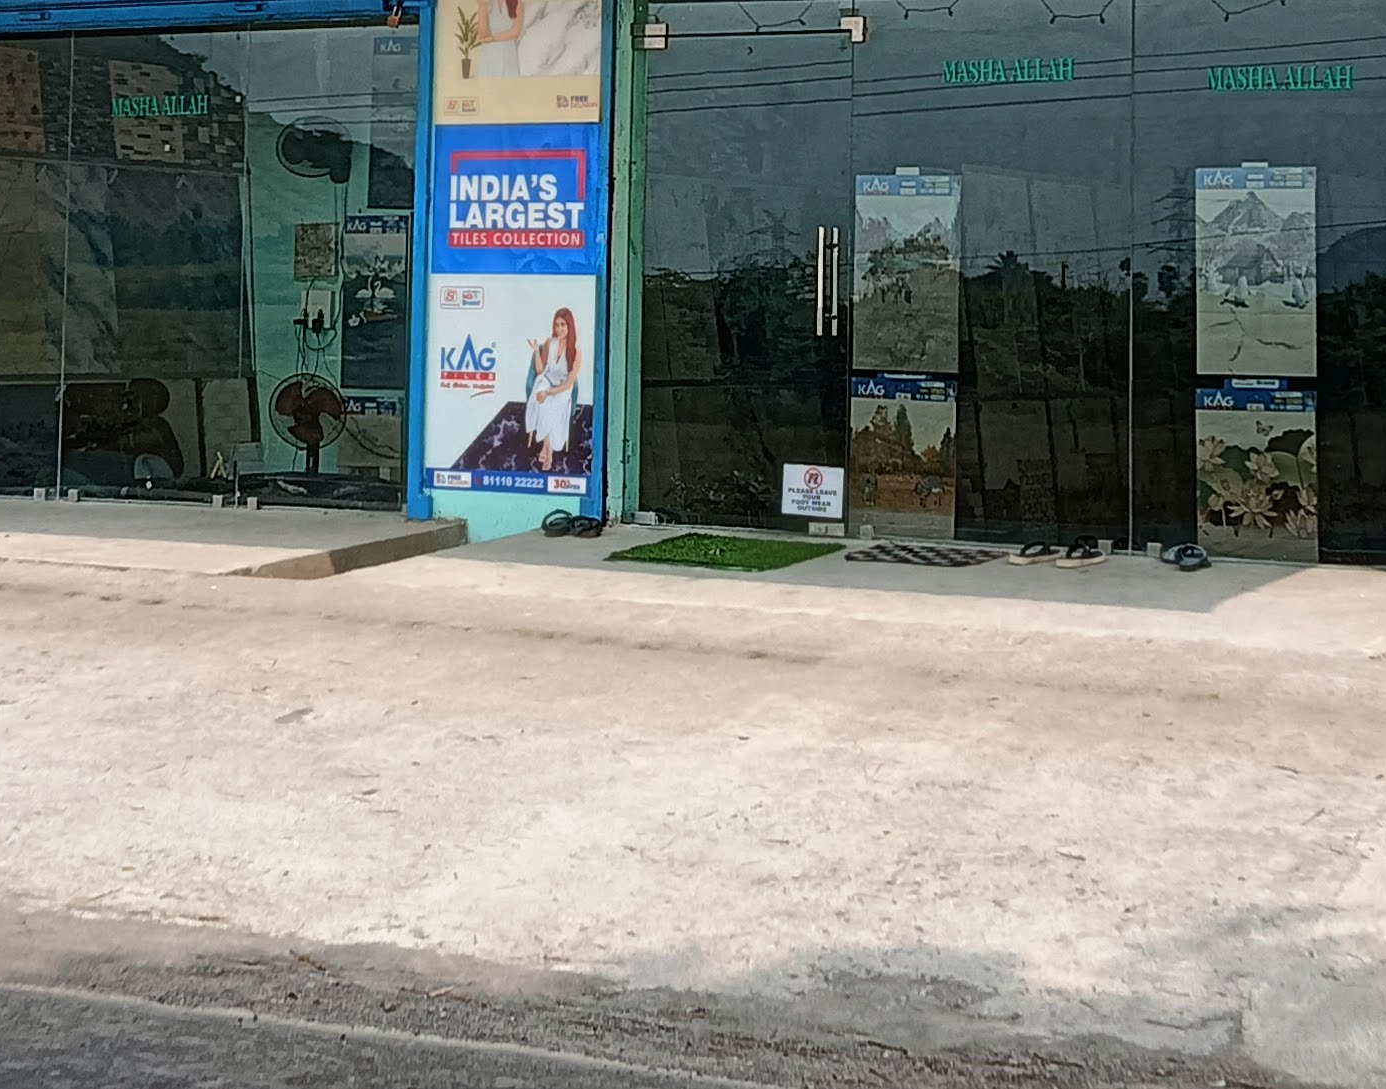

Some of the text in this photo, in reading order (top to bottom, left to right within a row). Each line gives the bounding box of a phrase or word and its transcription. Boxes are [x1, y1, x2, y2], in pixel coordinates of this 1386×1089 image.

[942, 56, 1075, 83] MASHA ALLAH
[1207, 64, 1354, 91] MASHA ALLAH
[111, 94, 209, 117] MASHA ALLAH
[450, 174, 558, 201] INDIA'S
[449, 202, 584, 229] LARGEST
[451, 232, 581, 246] TILES COLLECTION
[441, 333, 496, 371] KAG
